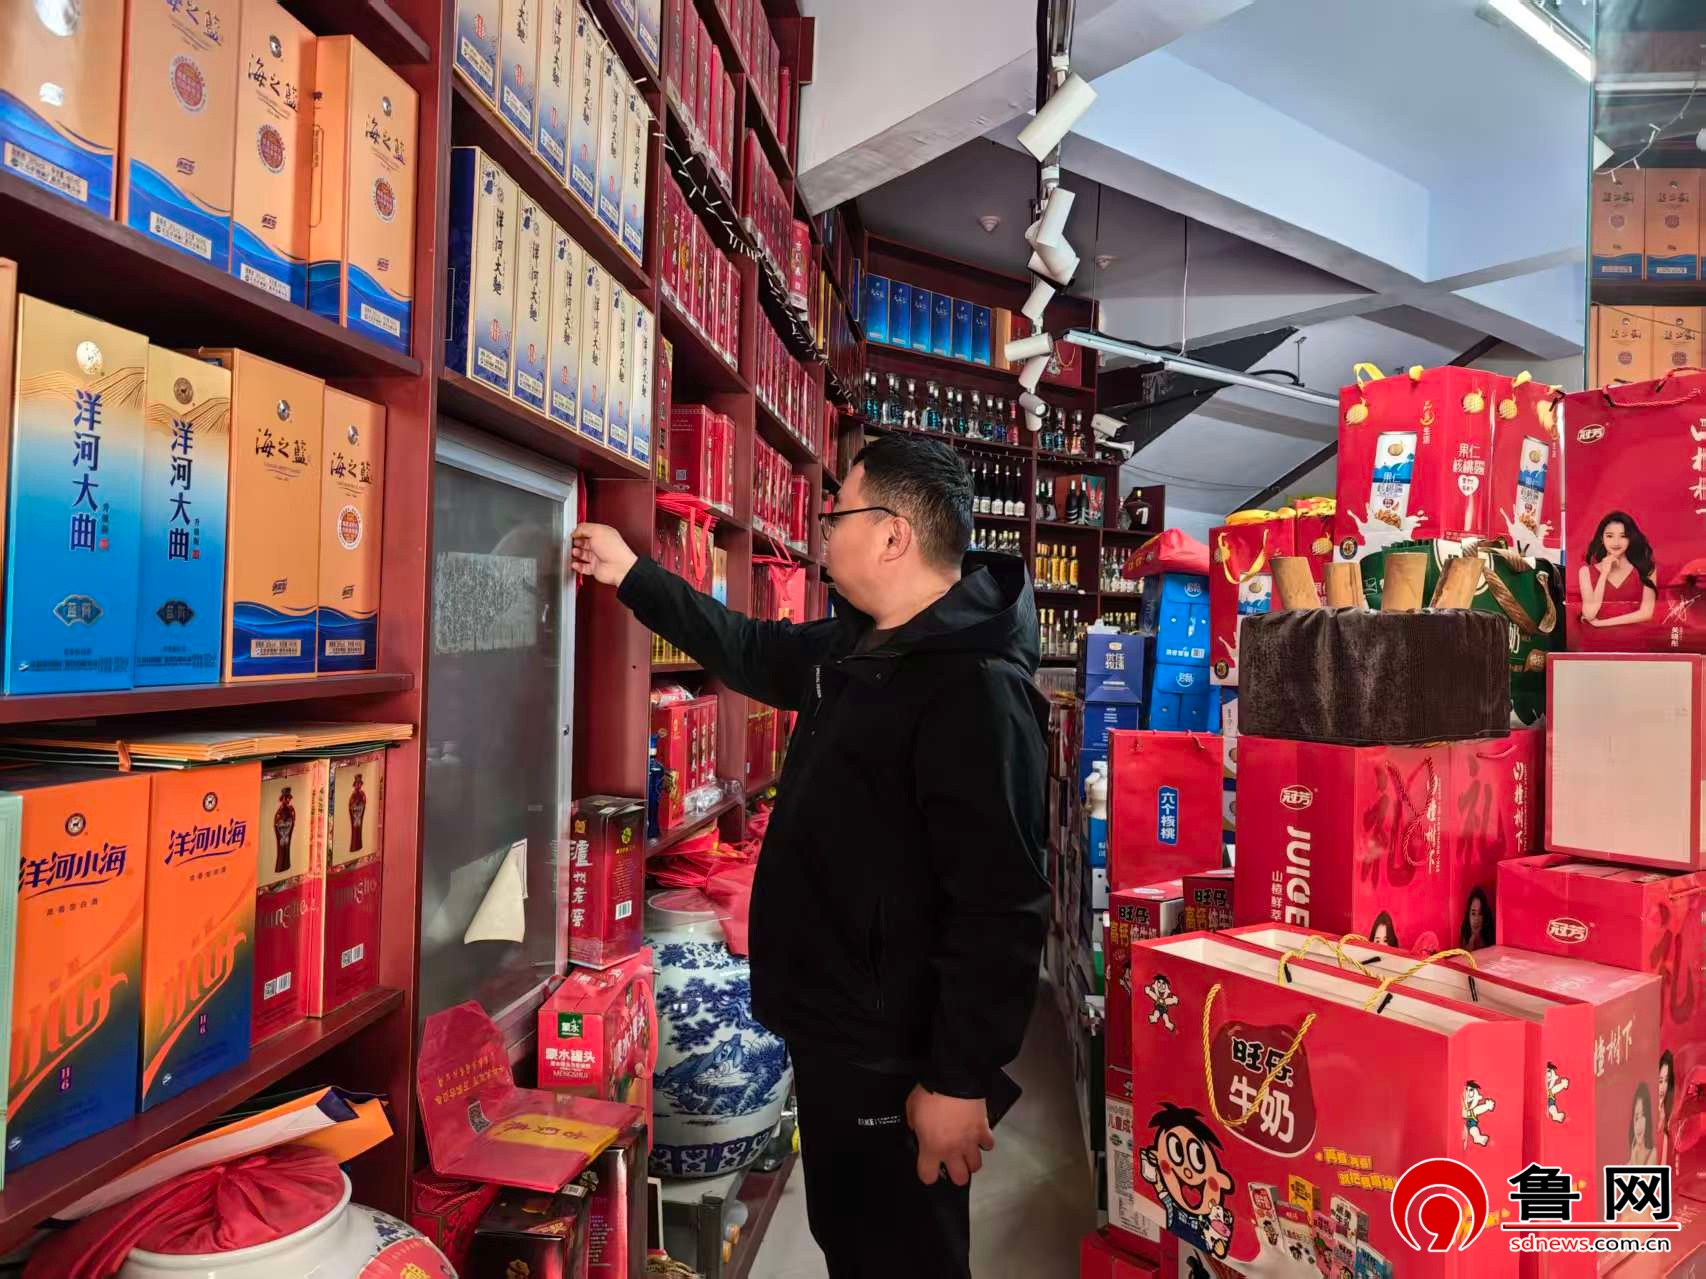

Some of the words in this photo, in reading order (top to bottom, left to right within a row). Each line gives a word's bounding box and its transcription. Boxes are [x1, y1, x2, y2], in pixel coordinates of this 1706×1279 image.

[70, 389, 103, 552] 洋河大曲
[1458, 442, 1481, 458] 果仁
[168, 417, 195, 561] 洋河大曲
[1160, 792, 1176, 840] 六个核桃
[1281, 787, 1312, 806] 冠芳
[165, 818, 248, 865] 洋河小海
[18, 842, 128, 892] 洋河小海
[1286, 825, 1312, 928] JUICE
[1119, 905, 1150, 923] 旺仔
[1549, 920, 1587, 941] 冠芳
[1231, 1037, 1295, 1083] 旺仔
[1108, 1112, 1134, 1134] 儿童成
[1229, 1074, 1295, 1144] 牛奶
